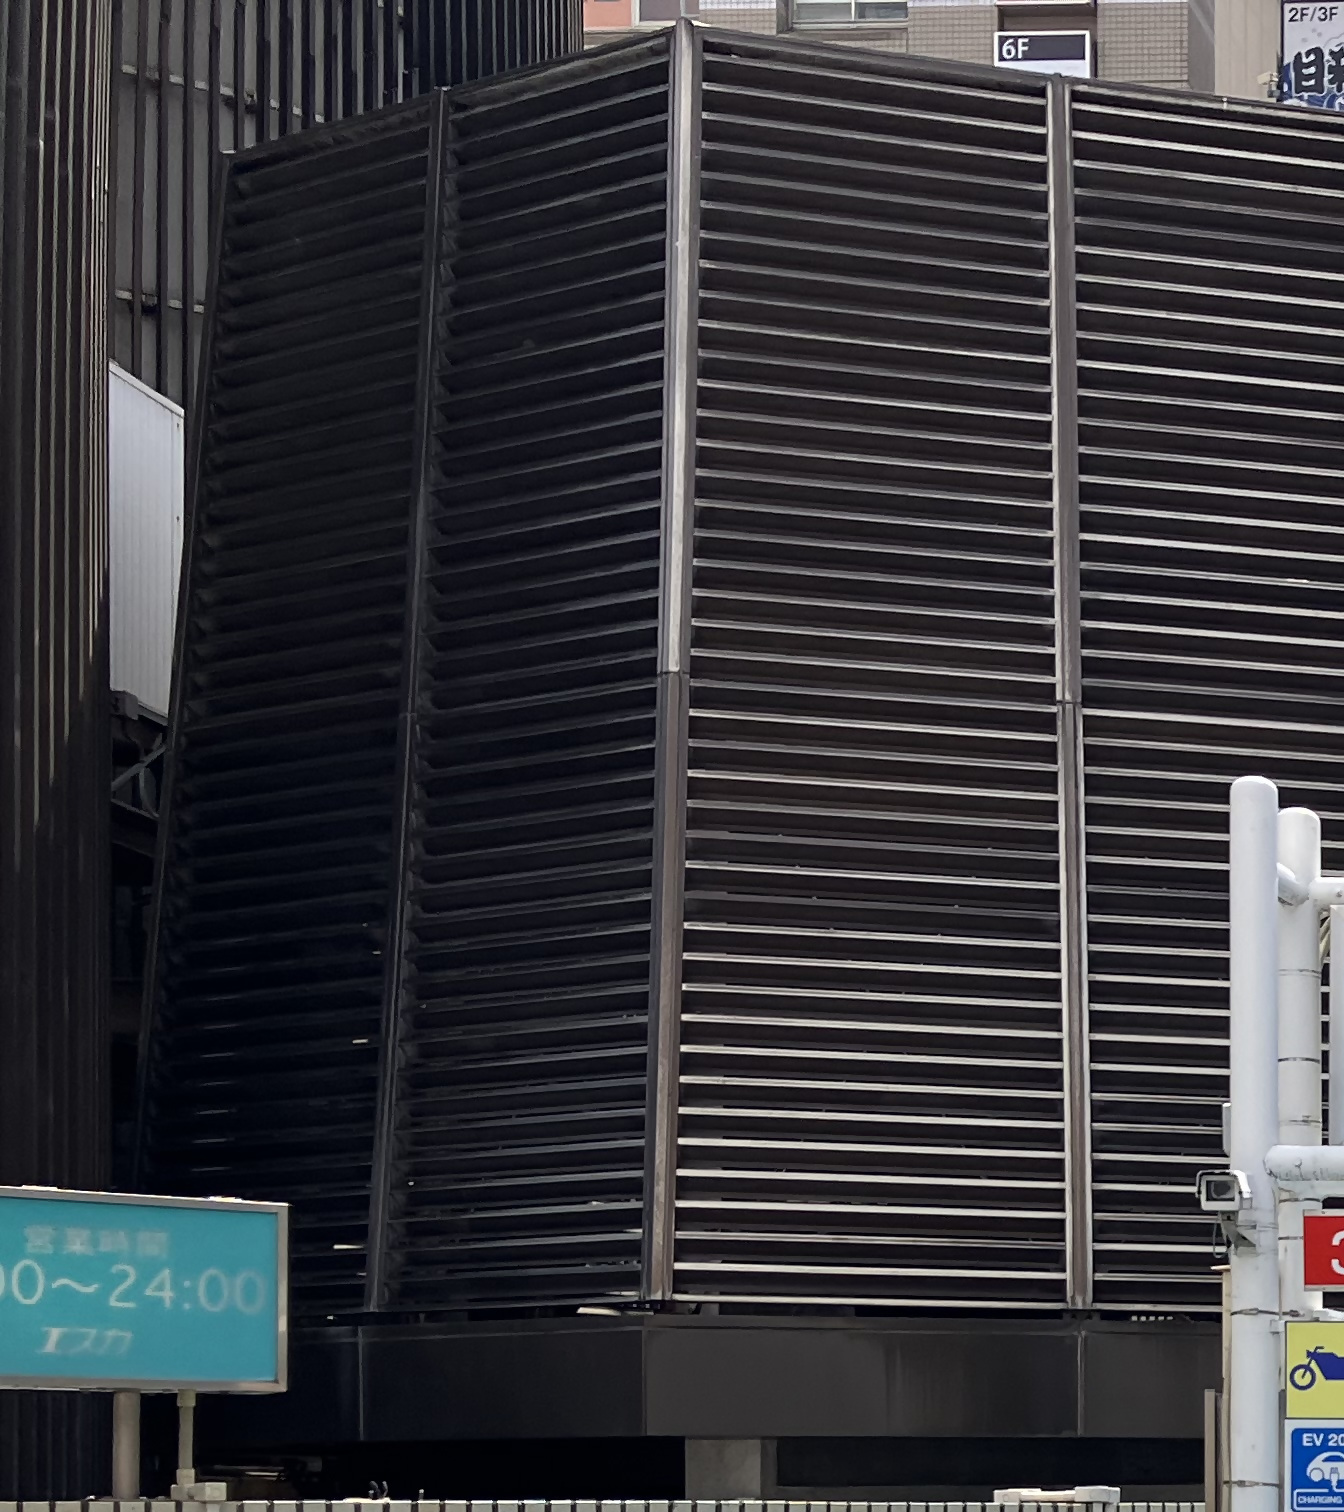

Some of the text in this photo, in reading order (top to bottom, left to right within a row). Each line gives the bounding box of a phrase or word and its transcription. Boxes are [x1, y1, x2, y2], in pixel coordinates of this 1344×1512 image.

[1288, 7, 1338, 22] 2F/3F
[1002, 38, 1029, 59] 6F
[1302, 1433, 1324, 1447] EV
[1297, 1495, 1343, 1505] CHARGING
